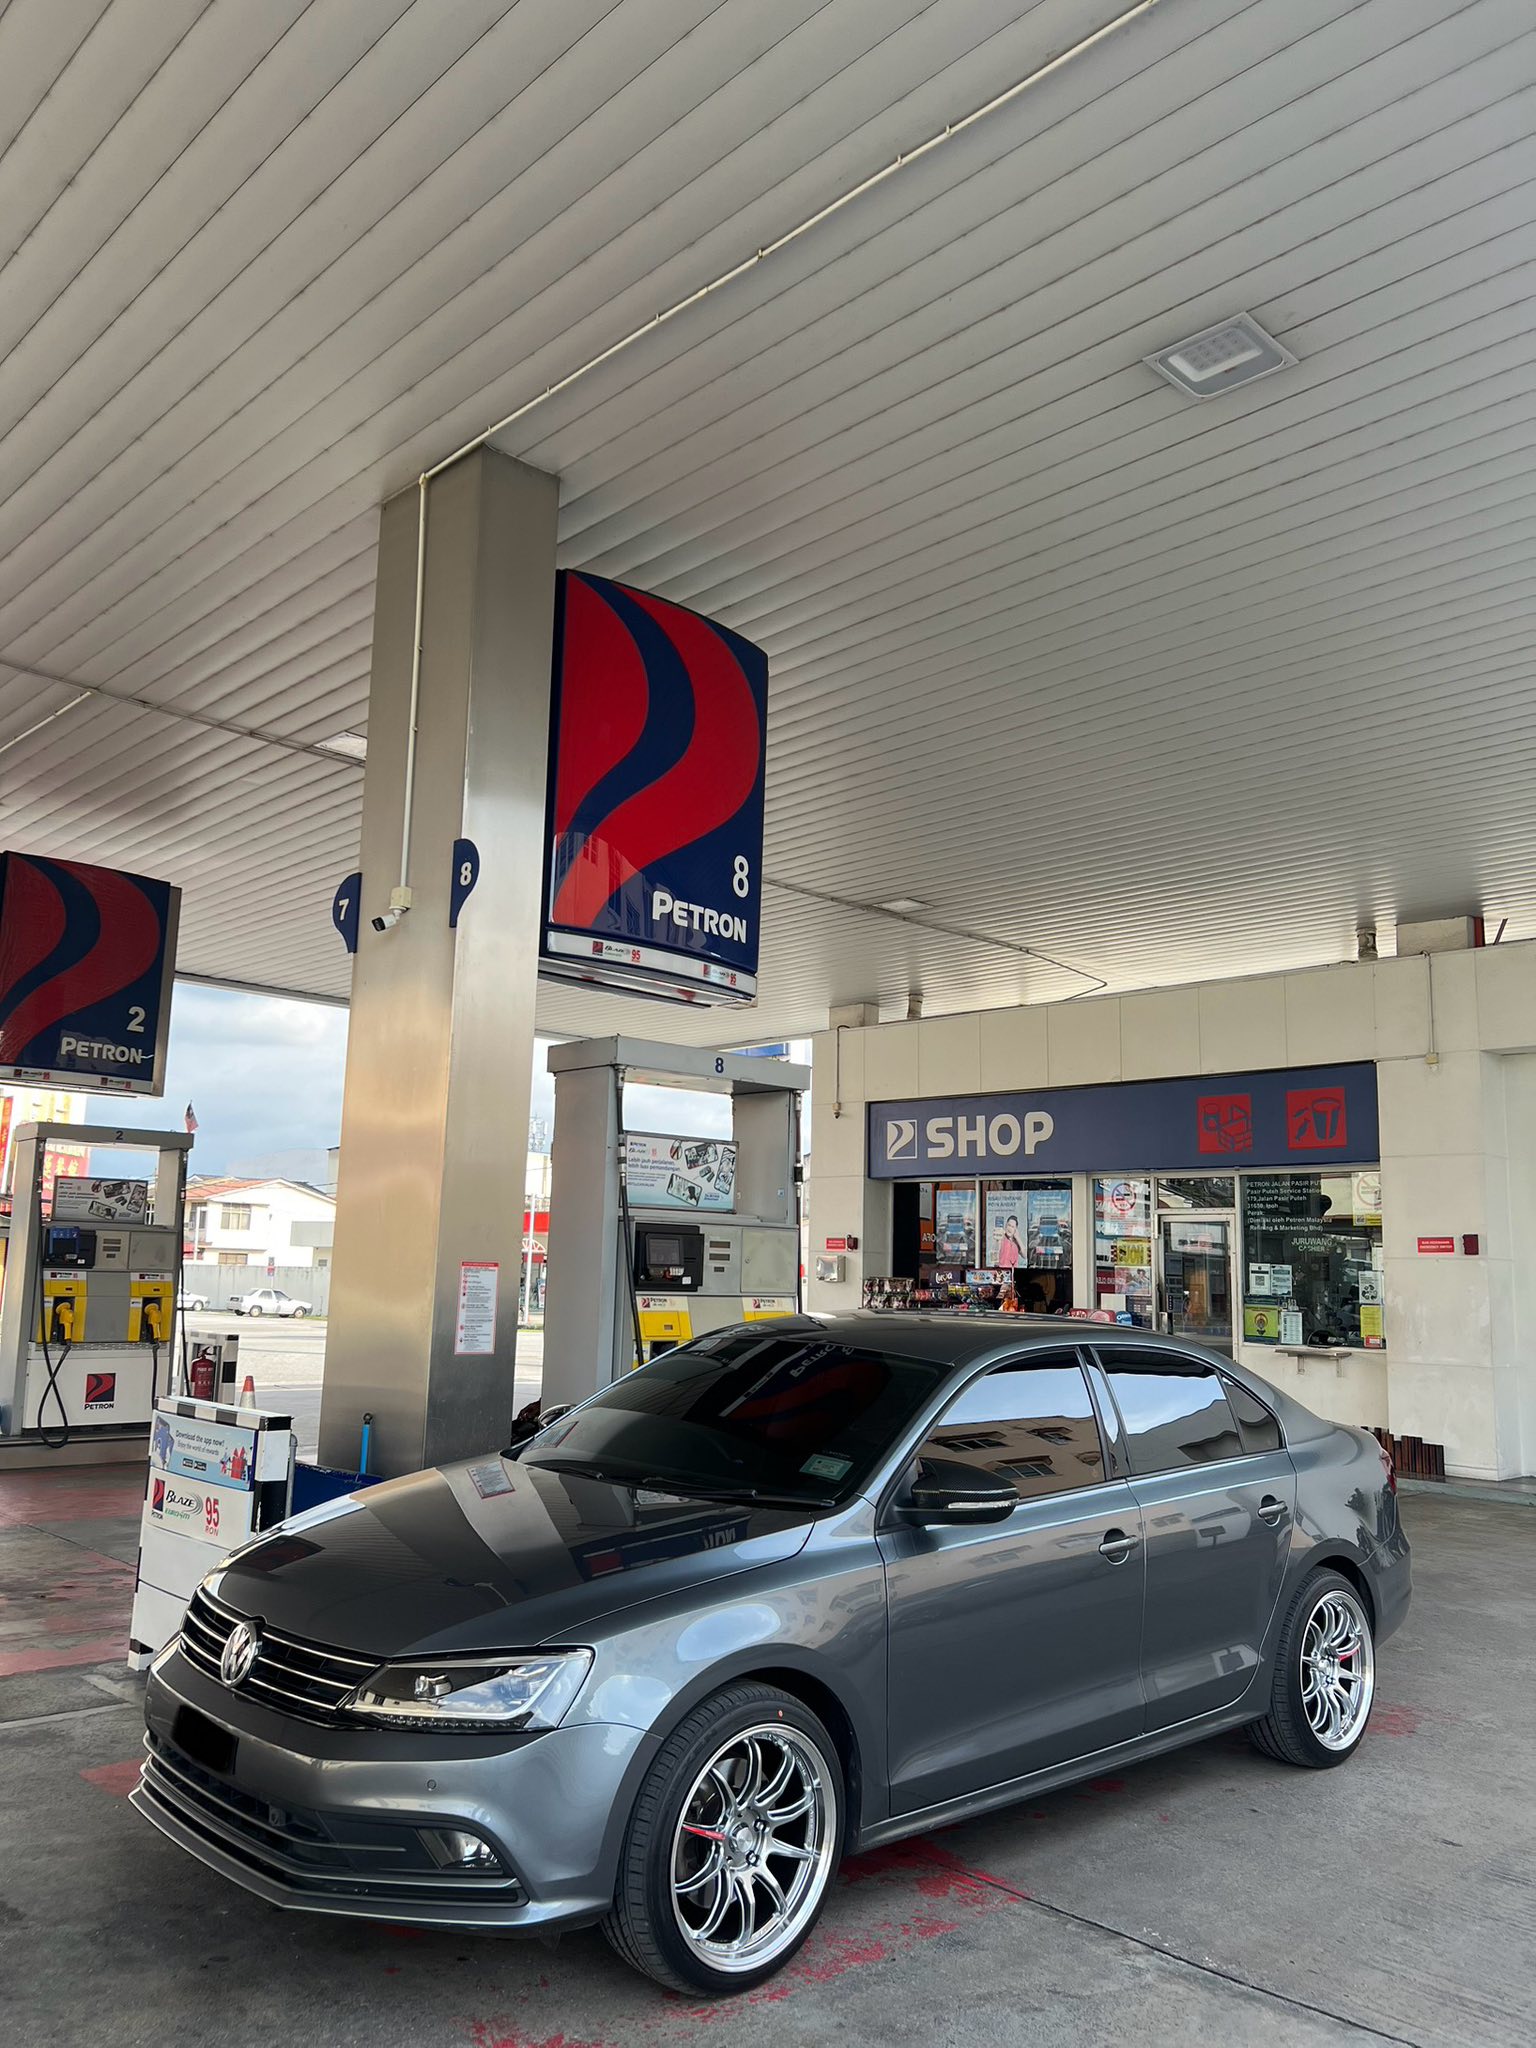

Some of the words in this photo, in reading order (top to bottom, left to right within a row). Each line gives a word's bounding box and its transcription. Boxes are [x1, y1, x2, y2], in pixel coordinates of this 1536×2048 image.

[460, 861, 472, 886] 8
[732, 854, 750, 898] 8
[338, 898, 350, 921] 7
[652, 890, 747, 944] PETRON
[126, 1006, 146, 1032] 2
[60, 1036, 142, 1064] PETRON
[715, 1057, 725, 1074] 8
[115, 1130, 124, 1140] 2
[926, 1111, 1055, 1159] SHOP
[1291, 1237, 1332, 1246] JURUWANG
[84, 1402, 115, 1411] PETRON
[166, 1489, 195, 1508] BLAZE
[205, 1496, 220, 1528] 95
[205, 1525, 219, 1536] RON
